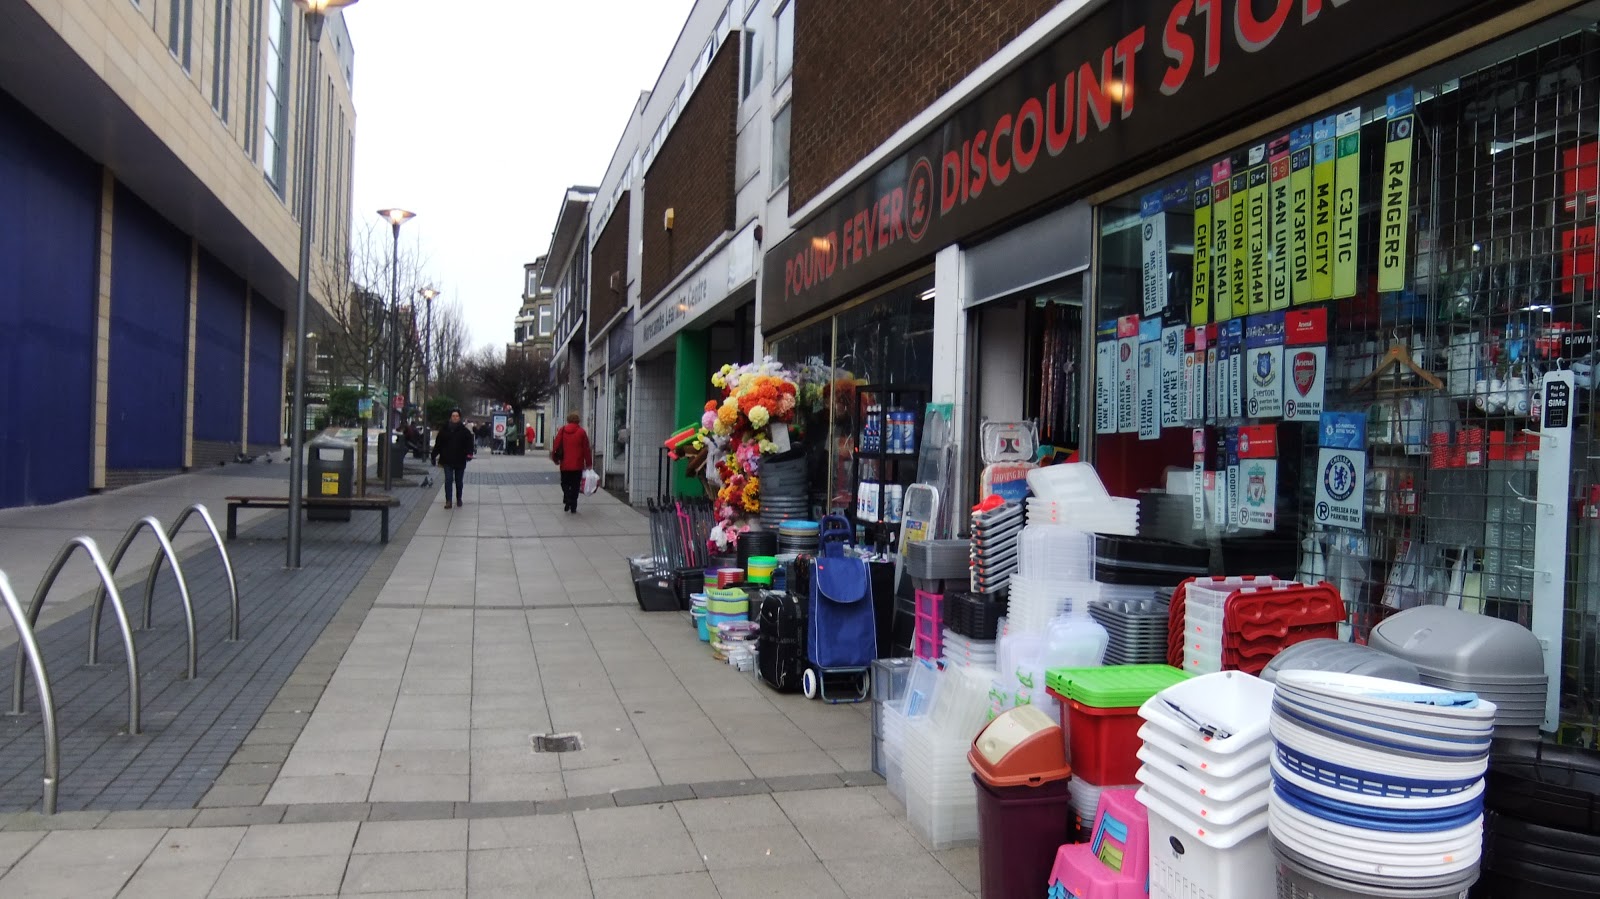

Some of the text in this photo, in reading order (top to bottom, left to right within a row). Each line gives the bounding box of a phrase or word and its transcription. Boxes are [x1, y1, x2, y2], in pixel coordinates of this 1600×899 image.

[785, 230, 838, 302] POUND
[842, 186, 904, 270] FEVER
[940, 25, 1146, 217] DISCOUNT
[1159, 0, 1350, 96] STO
[1315, 130, 1328, 139] City
[1252, 192, 1263, 304] TOTT3NH4M
[1274, 185, 1286, 300] M4N UNIT3D
[1294, 188, 1307, 282] EV3RTON
[1316, 182, 1329, 275] M4N CITY
[1338, 188, 1353, 264] C3LTIC
[1234, 199, 1244, 305] TOON 4RMY
[1126, 368, 1131, 380] N5
[1253, 389, 1275, 397] Everton
[1330, 455, 1351, 467] CHELSEA
[1195, 506, 1201, 519] RD
[1231, 512, 1236, 522] RD
[1331, 513, 1348, 521] PARKING
